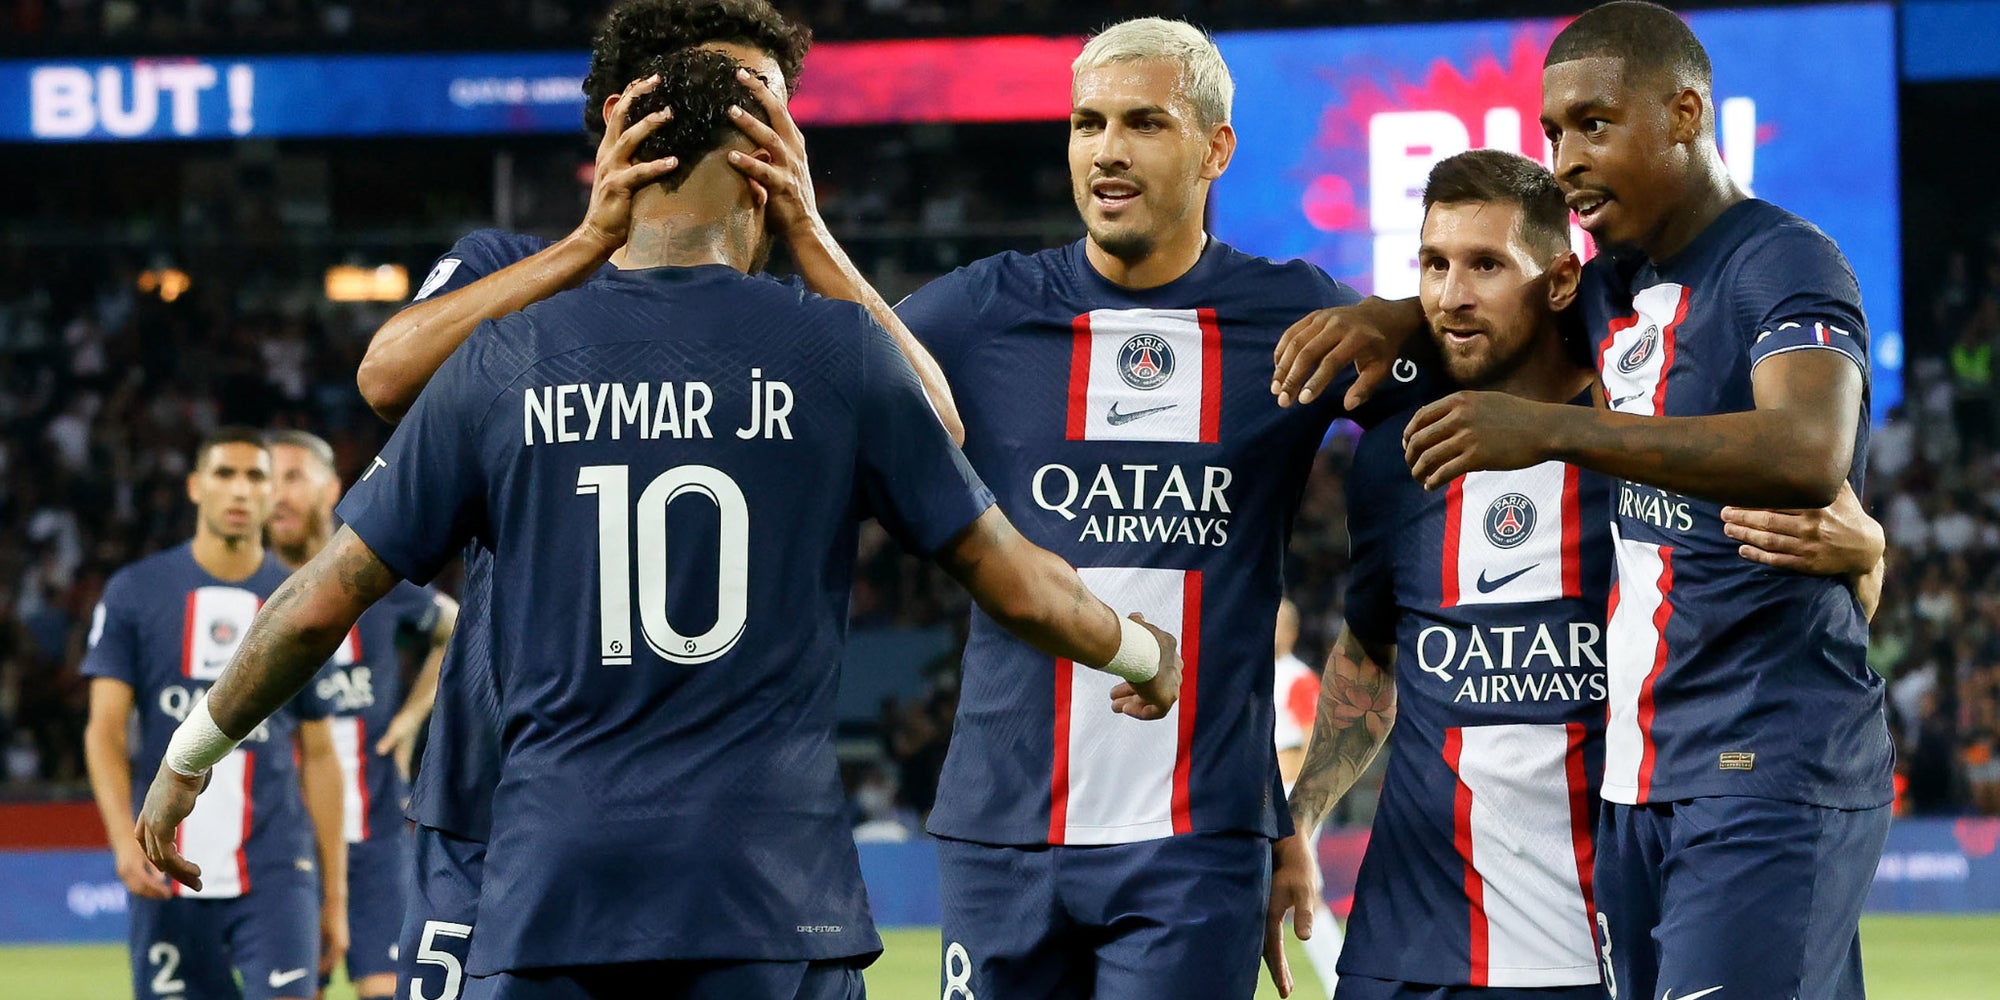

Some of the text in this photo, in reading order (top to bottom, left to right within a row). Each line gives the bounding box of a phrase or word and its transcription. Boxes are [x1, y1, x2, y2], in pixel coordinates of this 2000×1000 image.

[31, 64, 255, 138] BUT !
[1128, 338, 1165, 352] PARIS
[524, 381, 714, 446] NEYMAR
[1032, 463, 1232, 521] QATAR
[1494, 497, 1528, 511] PARIS
[1618, 487, 1693, 531] IRWAYS
[1079, 514, 1229, 547] AIRWAYS
[576, 464, 749, 665] 10
[1417, 622, 1605, 682] QATAR
[1454, 673, 1607, 703] AIRWAYS
[149, 942, 186, 994] 2
[409, 920, 473, 1000] 5
[942, 941, 975, 1000] 8
